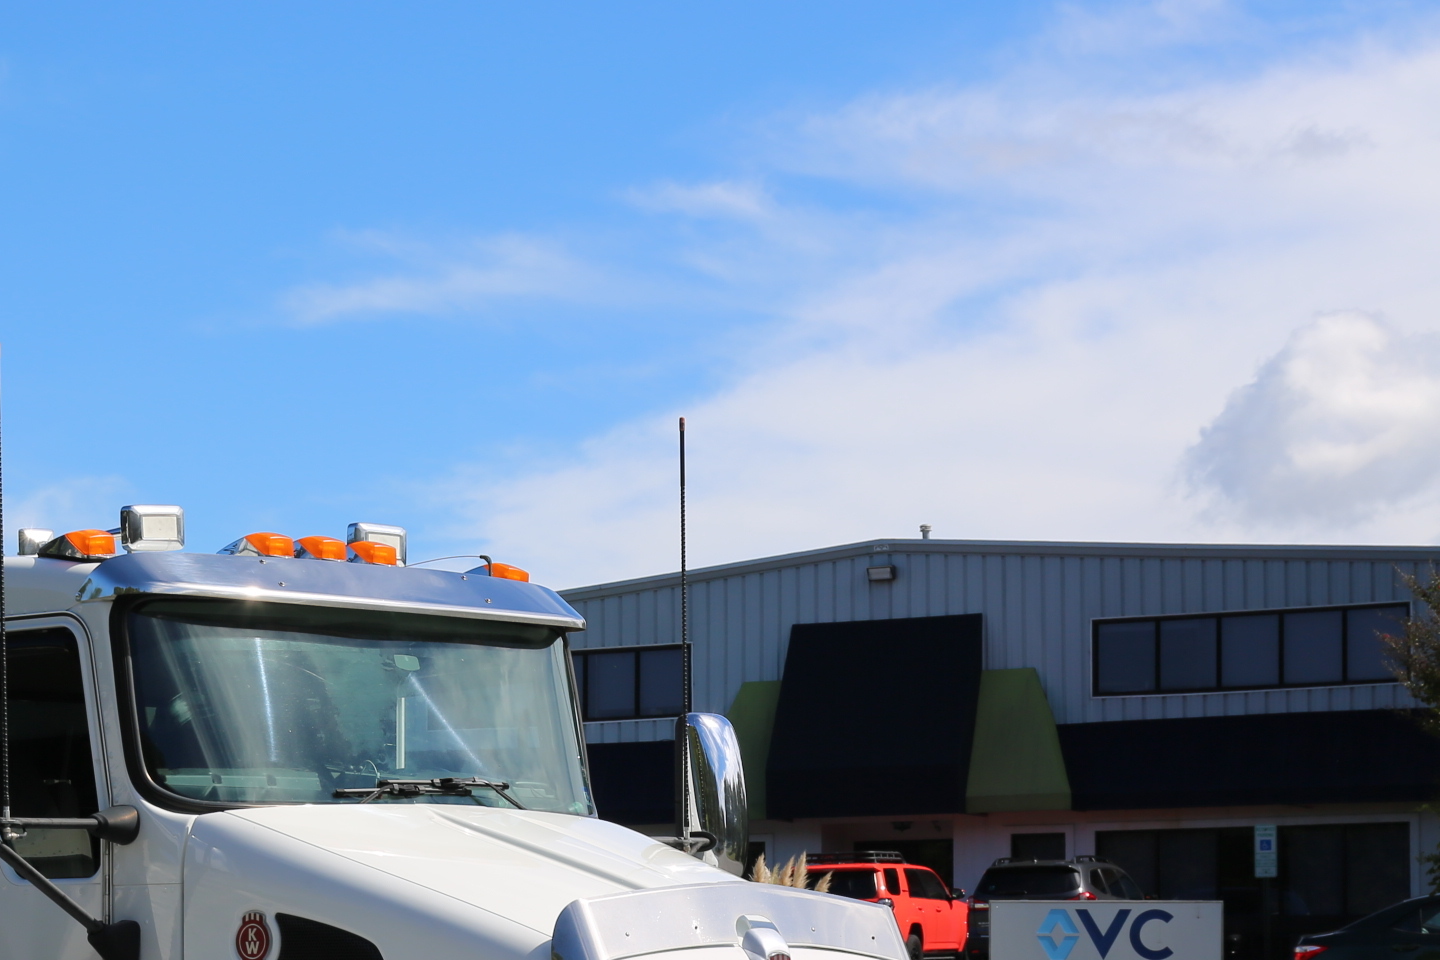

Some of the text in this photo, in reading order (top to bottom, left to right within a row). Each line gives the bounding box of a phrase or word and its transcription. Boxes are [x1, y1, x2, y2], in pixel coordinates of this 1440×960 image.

[248, 928, 257, 941] K
[1074, 908, 1174, 960] VC
[245, 941, 259, 955] W
